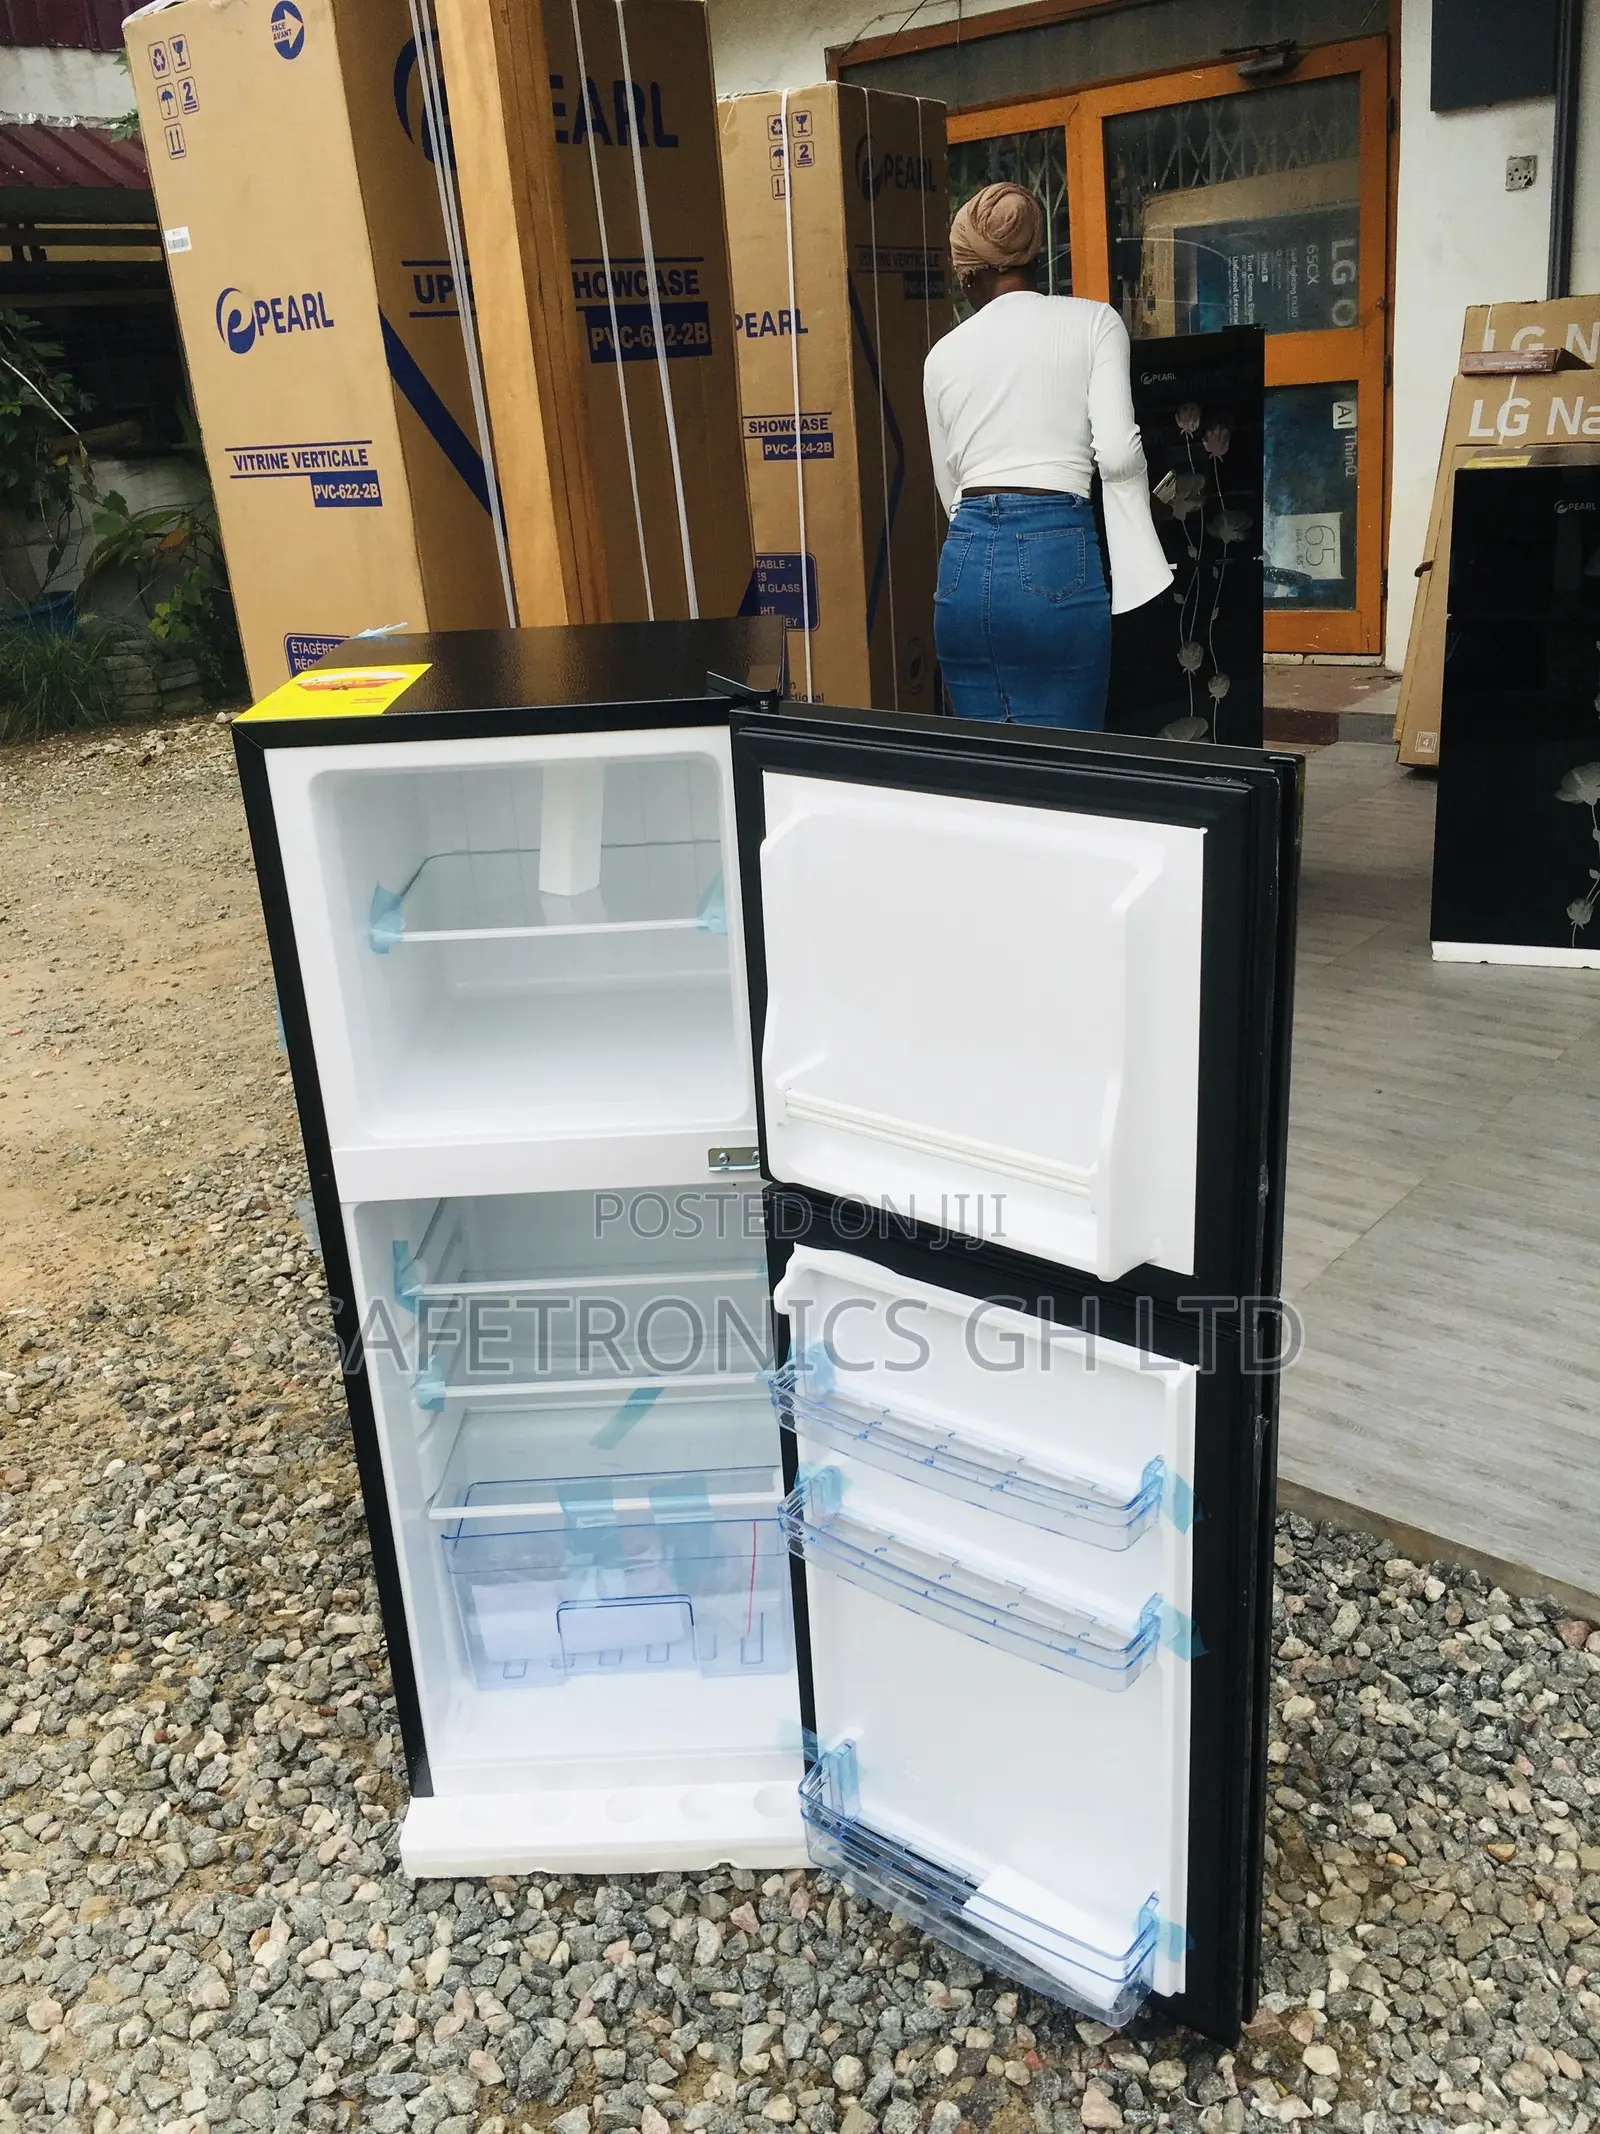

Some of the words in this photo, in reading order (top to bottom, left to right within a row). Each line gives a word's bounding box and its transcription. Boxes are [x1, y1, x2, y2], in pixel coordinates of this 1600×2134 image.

[271, 21, 287, 33] FACE
[273, 28, 293, 41] AVANT
[1306, 244, 1320, 286] 65CX
[1331, 238, 1357, 286] LG
[571, 269, 700, 299] HOWCASE
[254, 291, 335, 337] PEARL
[590, 321, 710, 352] PVC-62-2B
[1151, 372, 1177, 382] PEARL
[1468, 397, 1532, 438] LG
[233, 454, 289, 471] VITRINE
[292, 448, 369, 469] VERTICALE
[313, 482, 380, 500] PVC-622-2B
[1567, 502, 1597, 512] PEARL
[1304, 524, 1337, 567] 65
[767, 583, 800, 593] GLASS
